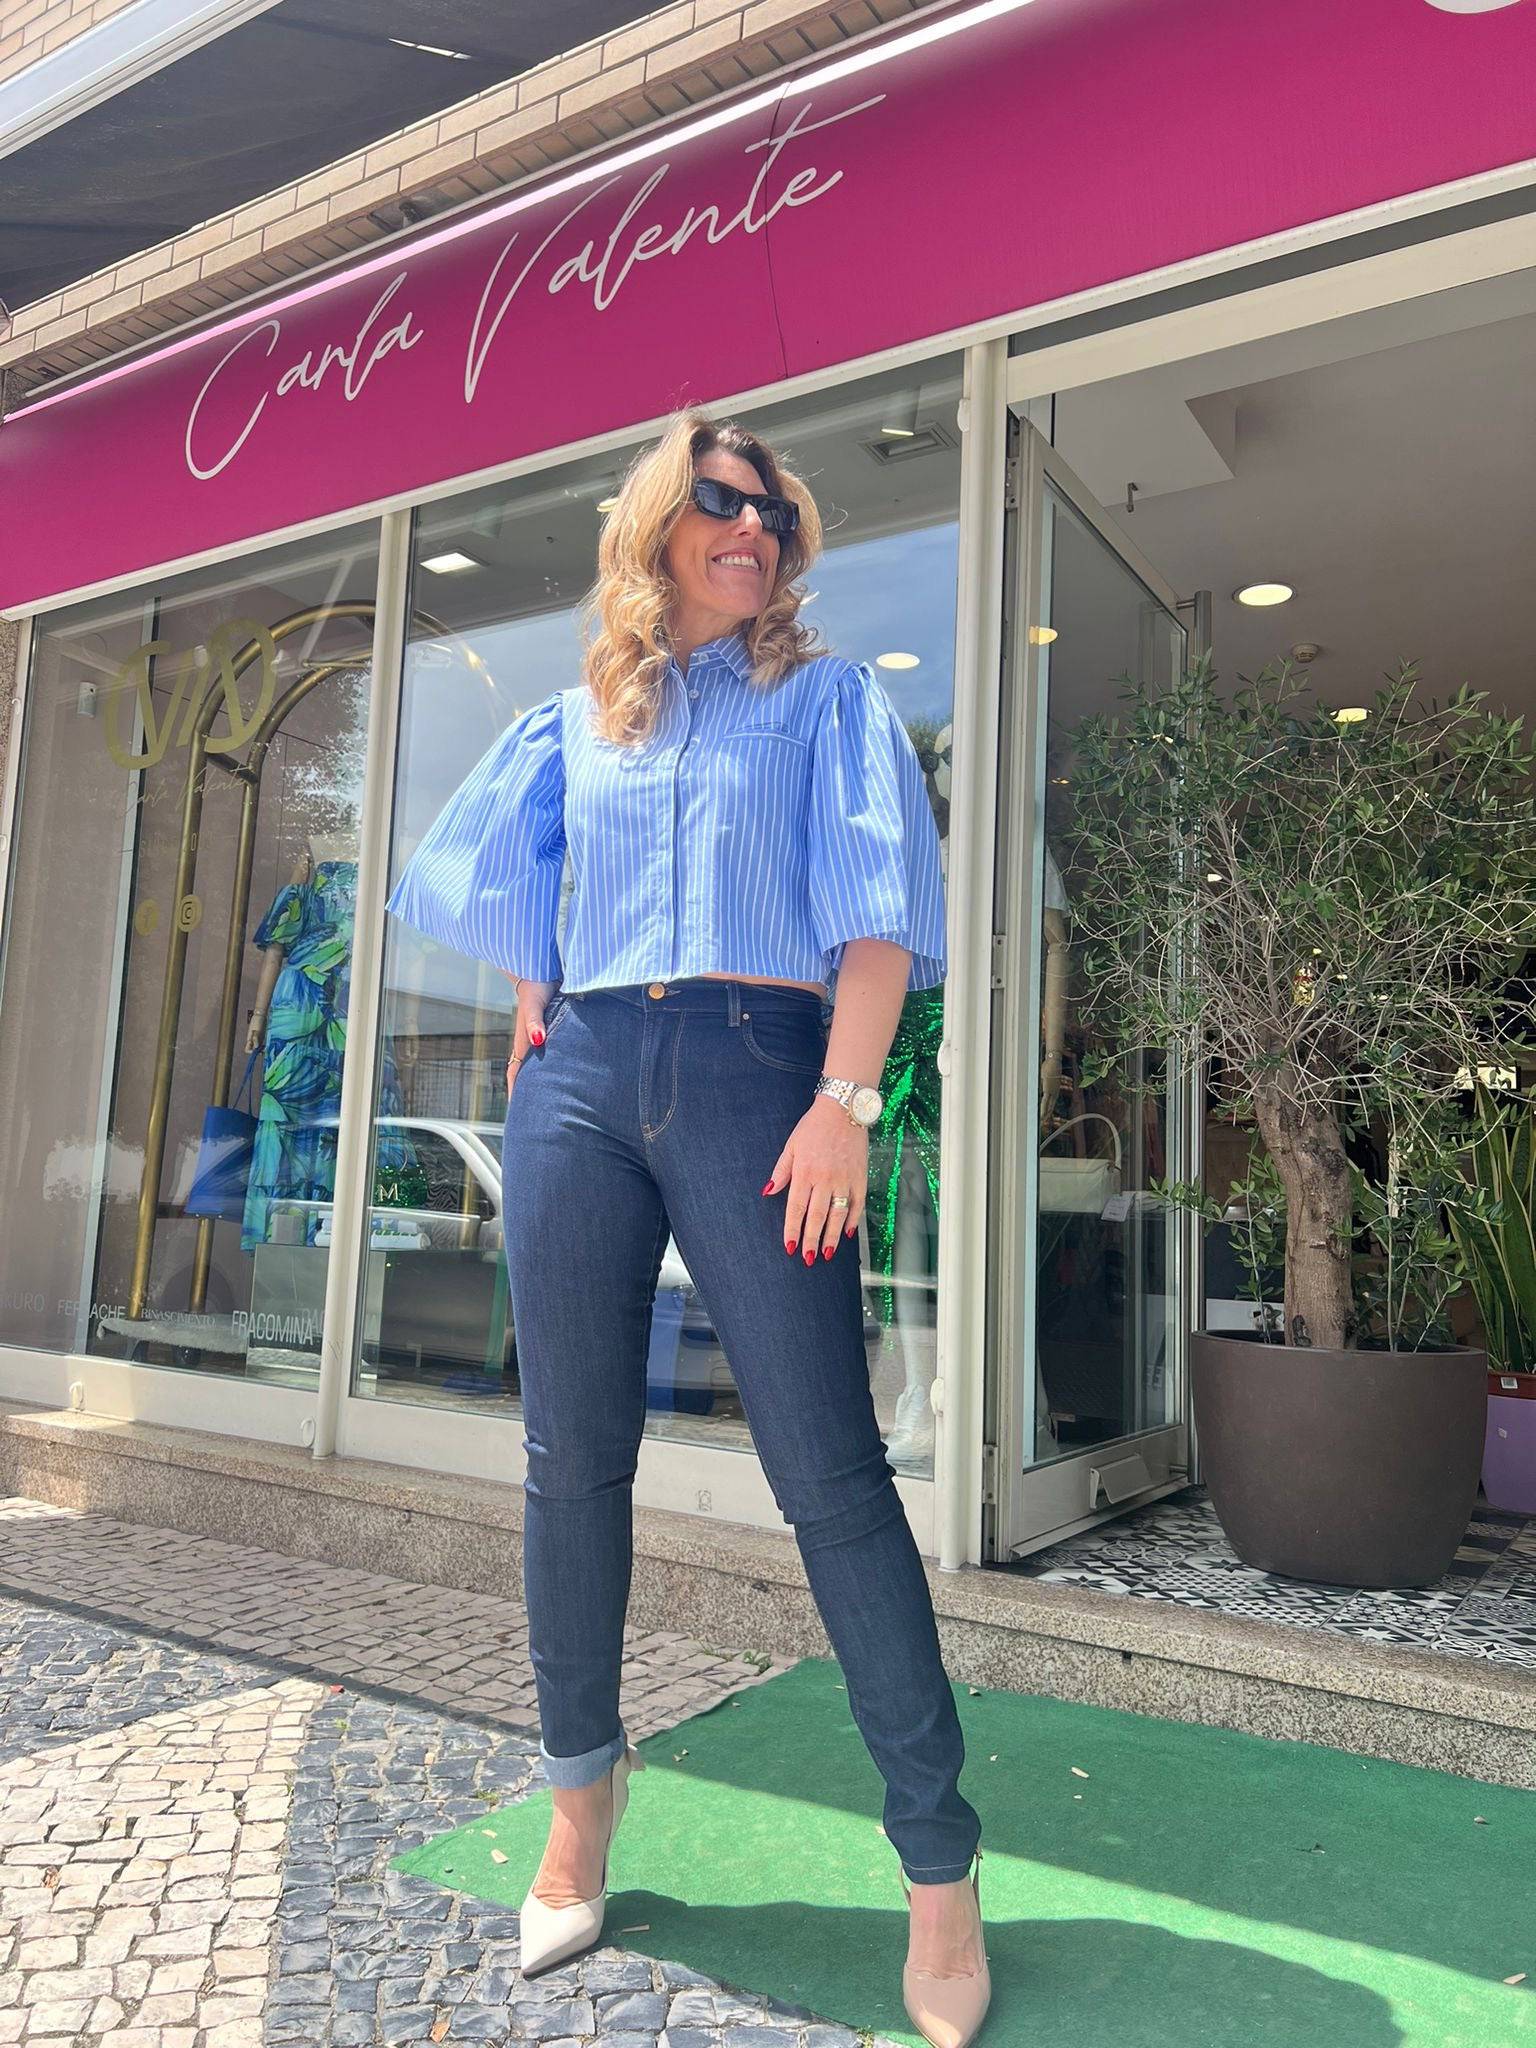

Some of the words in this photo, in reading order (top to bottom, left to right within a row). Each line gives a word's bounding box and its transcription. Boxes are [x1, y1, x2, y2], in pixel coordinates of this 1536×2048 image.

[185, 272, 425, 481] Carla
[464, 93, 888, 404] Valente
[378, 1183, 400, 1202] M
[231, 1310, 314, 1346] FRACOMINA
